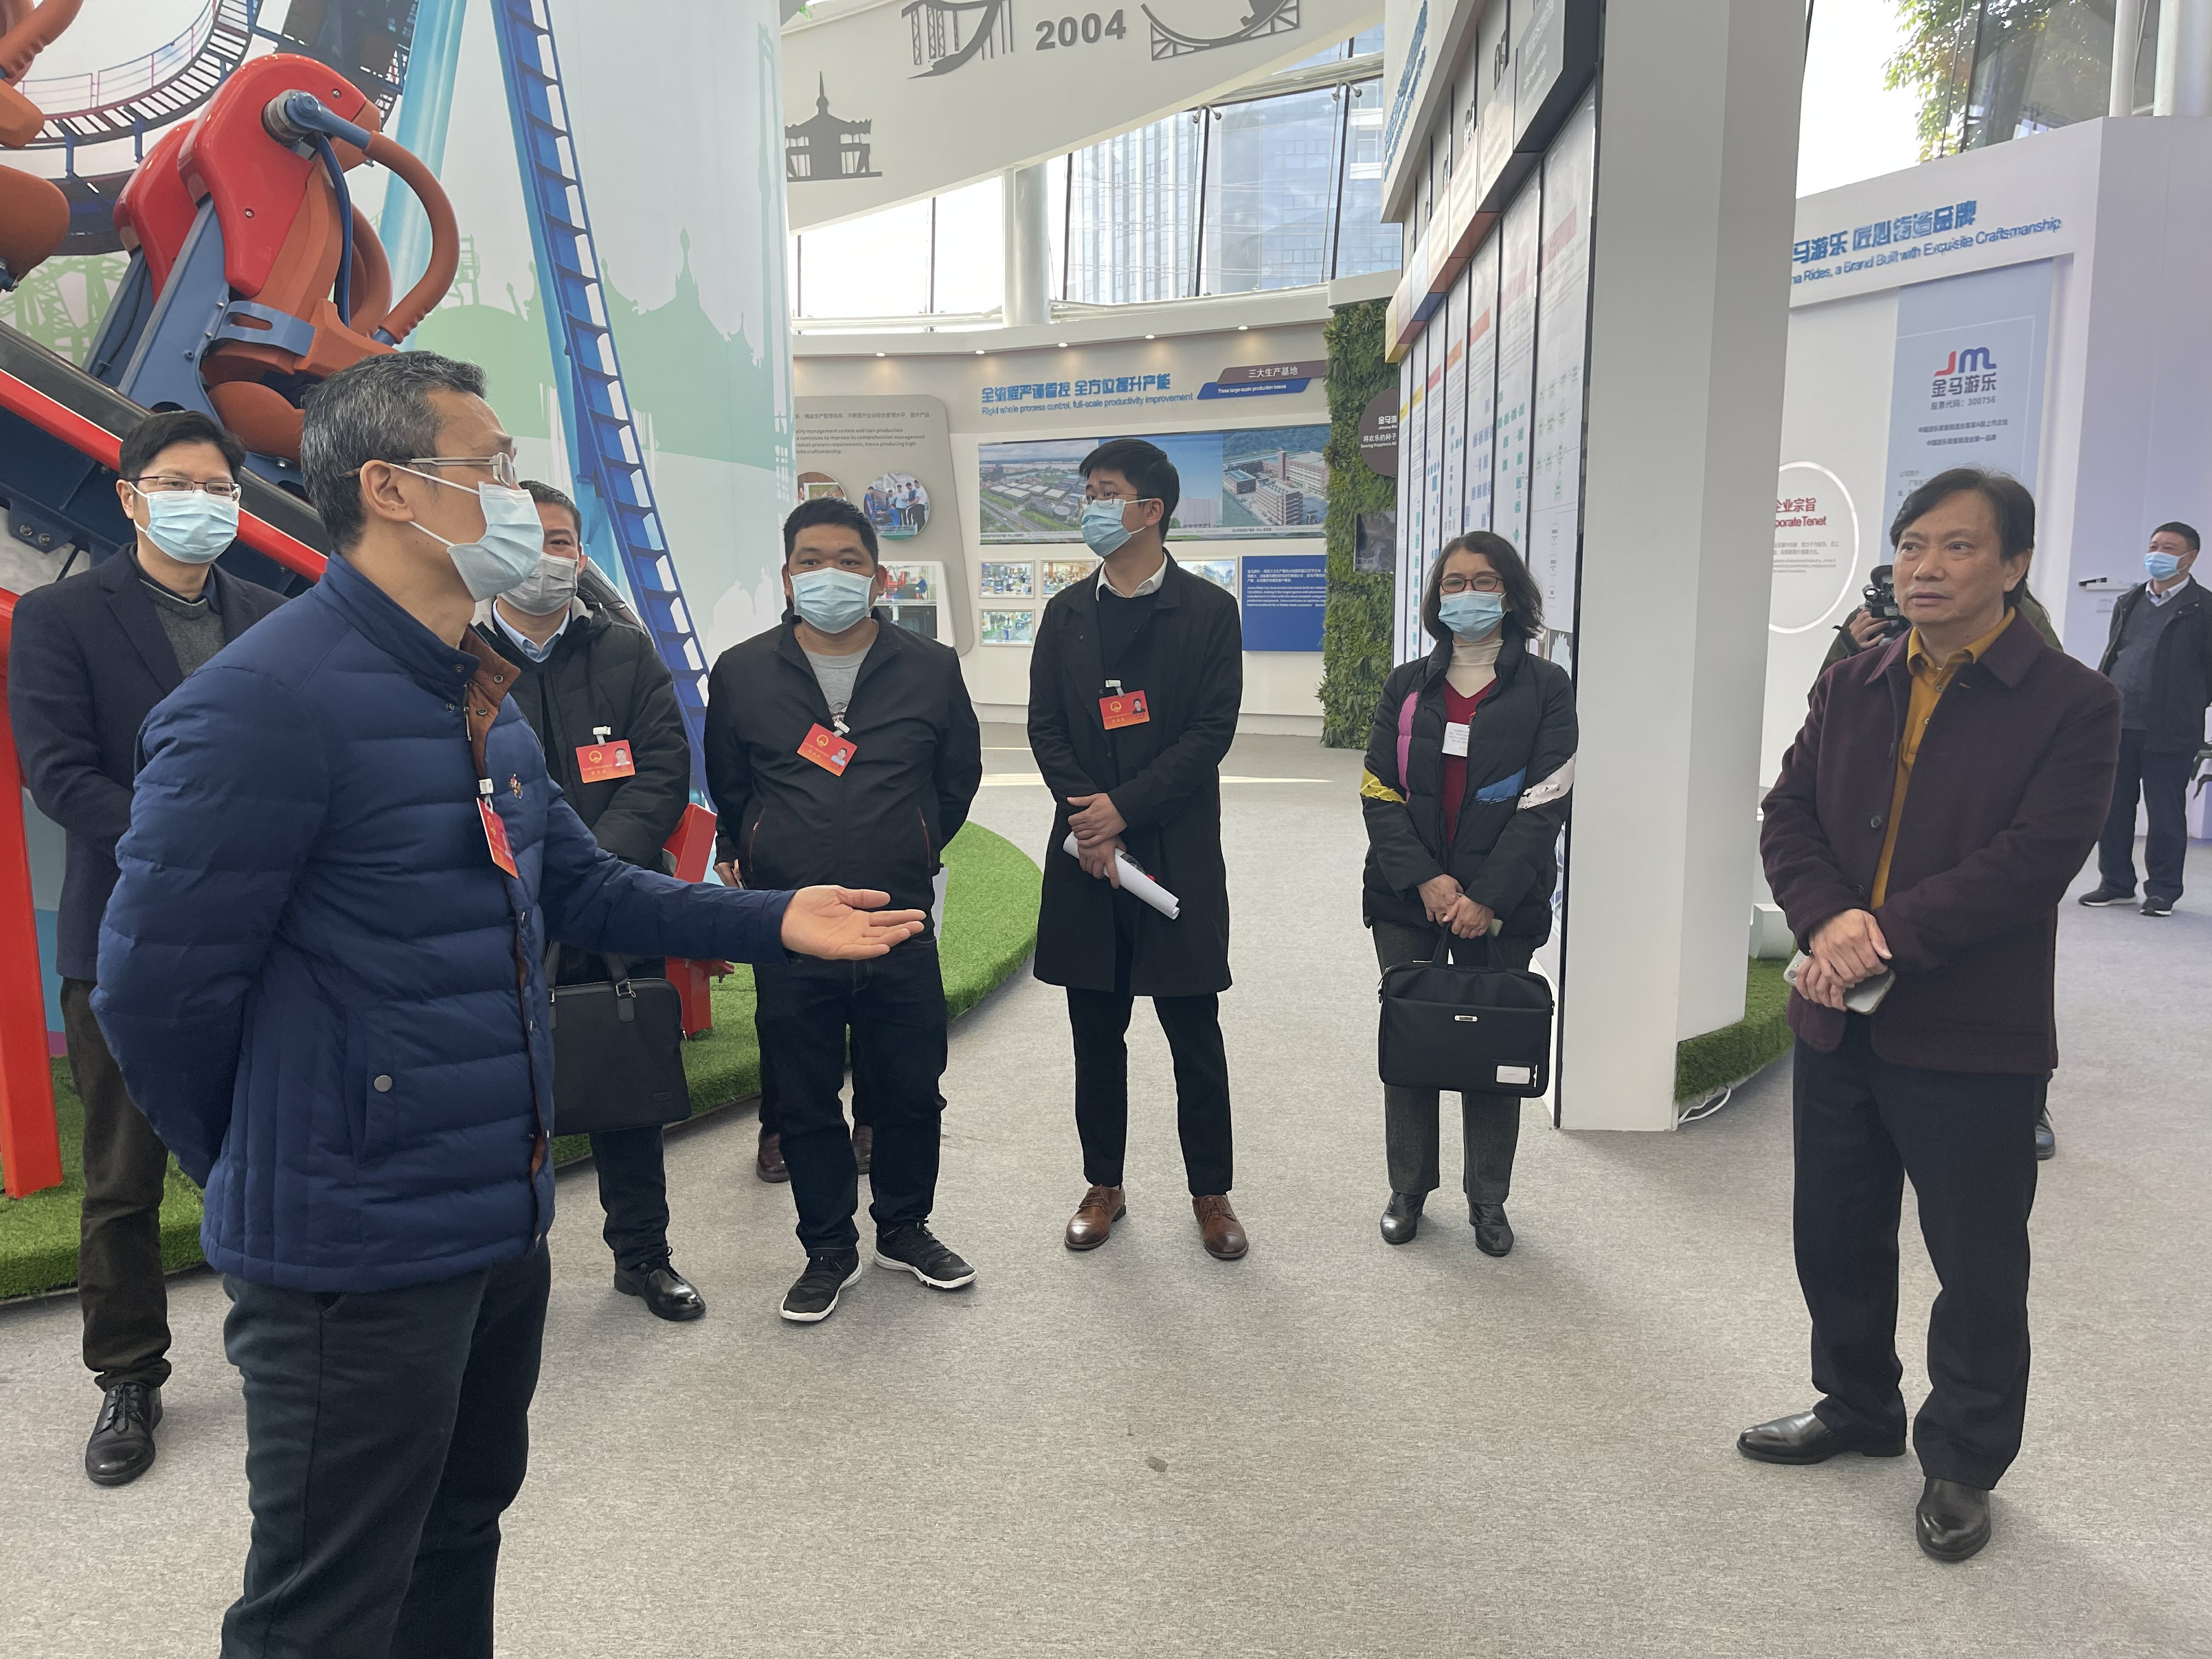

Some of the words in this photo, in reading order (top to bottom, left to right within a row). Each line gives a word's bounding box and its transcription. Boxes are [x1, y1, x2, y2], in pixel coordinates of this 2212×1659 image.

[1036, 9, 1126, 50] 2004
[1793, 230, 1848, 264] 马游乐
[1853, 200, 1977, 251] 匠心铸造品牌
[1804, 268, 1833, 281] Rides,
[1835, 266, 1842, 274] a
[1844, 255, 1874, 273] Brand
[1876, 250, 1898, 266] Built
[1900, 246, 1921, 261] with
[1923, 235, 1974, 256] Exquisite
[1976, 217, 2062, 245] Craftsmanship
[1249, 366, 1298, 377] 三大生产基地
[982, 382, 1071, 403] 全流程严谨管控
[1075, 373, 1170, 396] 全方位提升产能
[1931, 372, 1997, 398] 金马游乐
[982, 407, 998, 416] Rigid
[1020, 404, 1046, 413] process
[1047, 402, 1071, 410] control,
[1073, 399, 1103, 409] full-scale
[1104, 396, 1144, 408] productivity
[1146, 392, 1193, 404] improvement
[1776, 498, 1816, 512] 企业宗旨
[1802, 516, 1826, 526] Tenet
